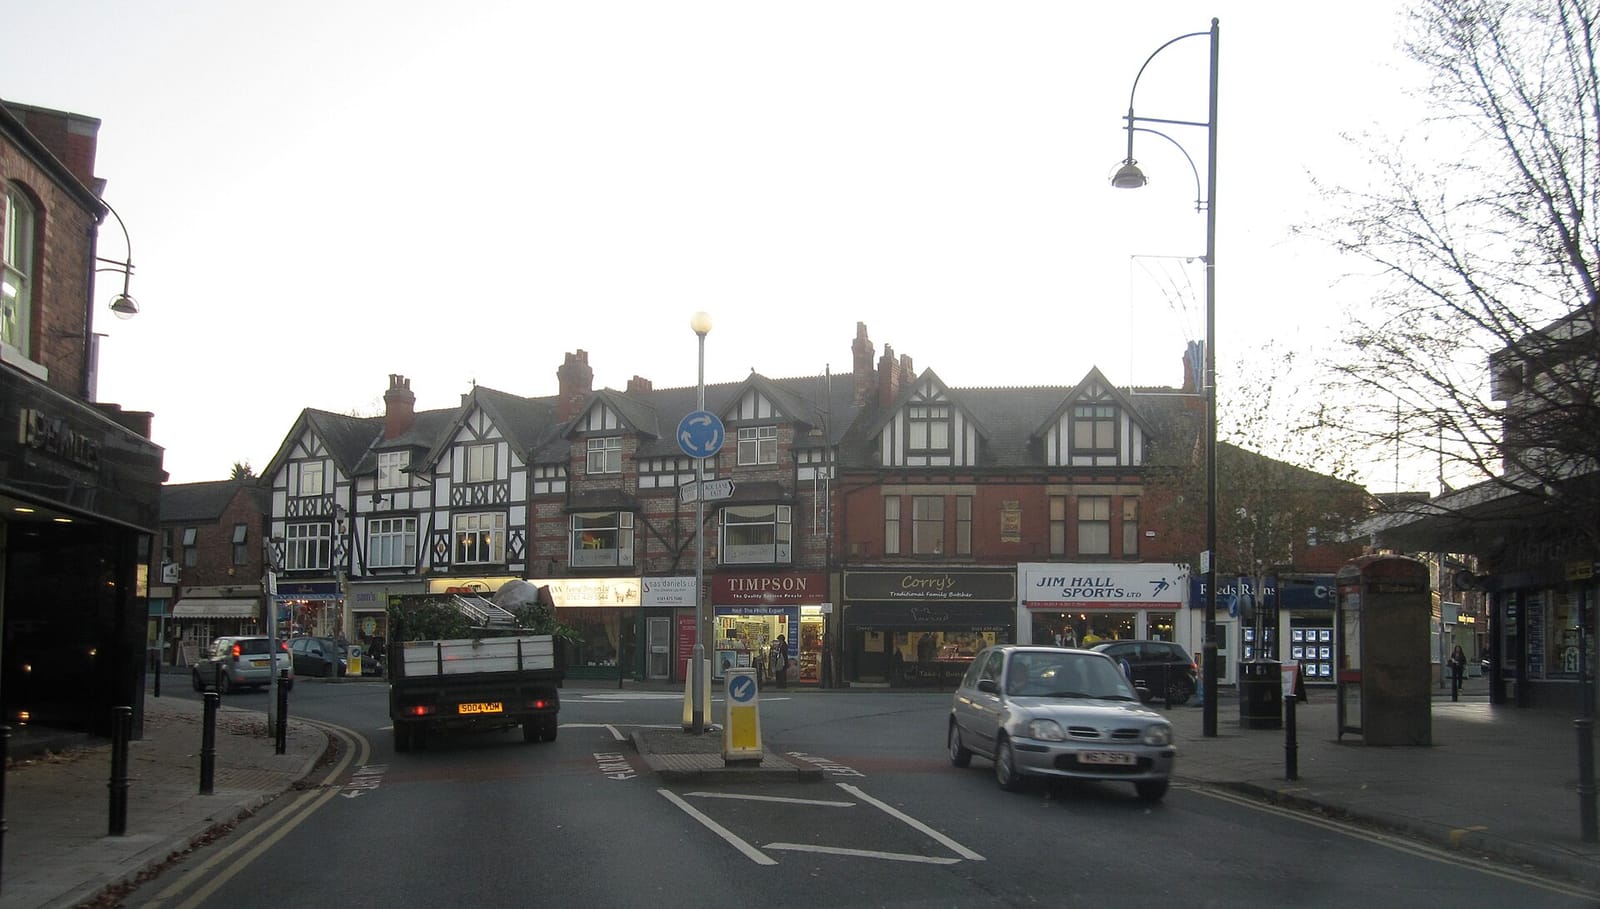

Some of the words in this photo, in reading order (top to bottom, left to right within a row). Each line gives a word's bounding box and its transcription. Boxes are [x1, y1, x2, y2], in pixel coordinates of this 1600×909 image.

[663, 579, 686, 588] daniels
[727, 577, 807, 591] TIMPSON
[902, 575, 956, 591] Corry's
[1036, 576, 1065, 587] JIM
[1067, 576, 1115, 587] HALL
[926, 591, 947, 599] Family
[1062, 587, 1124, 598] SPORTS
